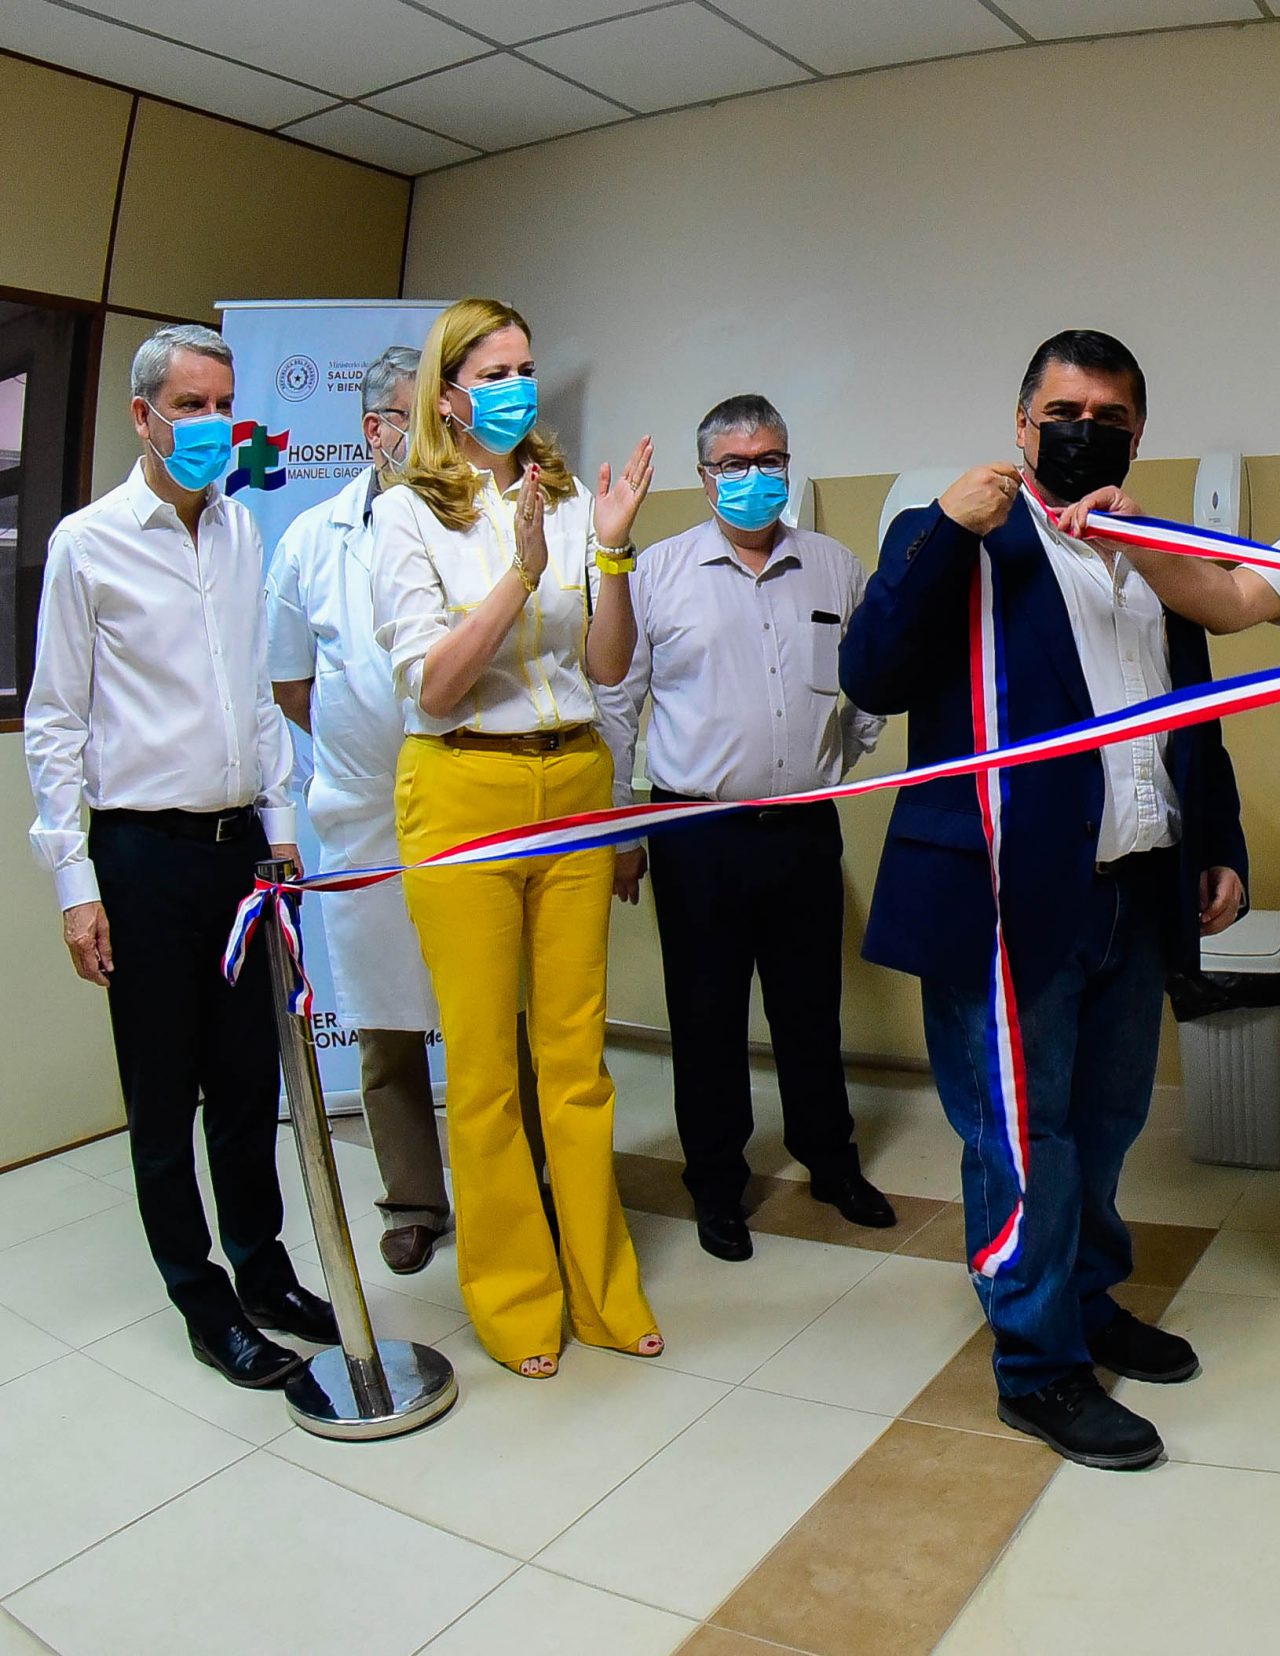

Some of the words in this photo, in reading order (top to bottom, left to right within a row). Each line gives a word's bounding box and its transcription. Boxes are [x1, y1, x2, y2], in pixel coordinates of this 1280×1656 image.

[327, 370, 363, 380] SALUD
[327, 382, 334, 392] Y
[288, 443, 373, 462] HOSPITAL
[288, 467, 330, 480] MANUEL
